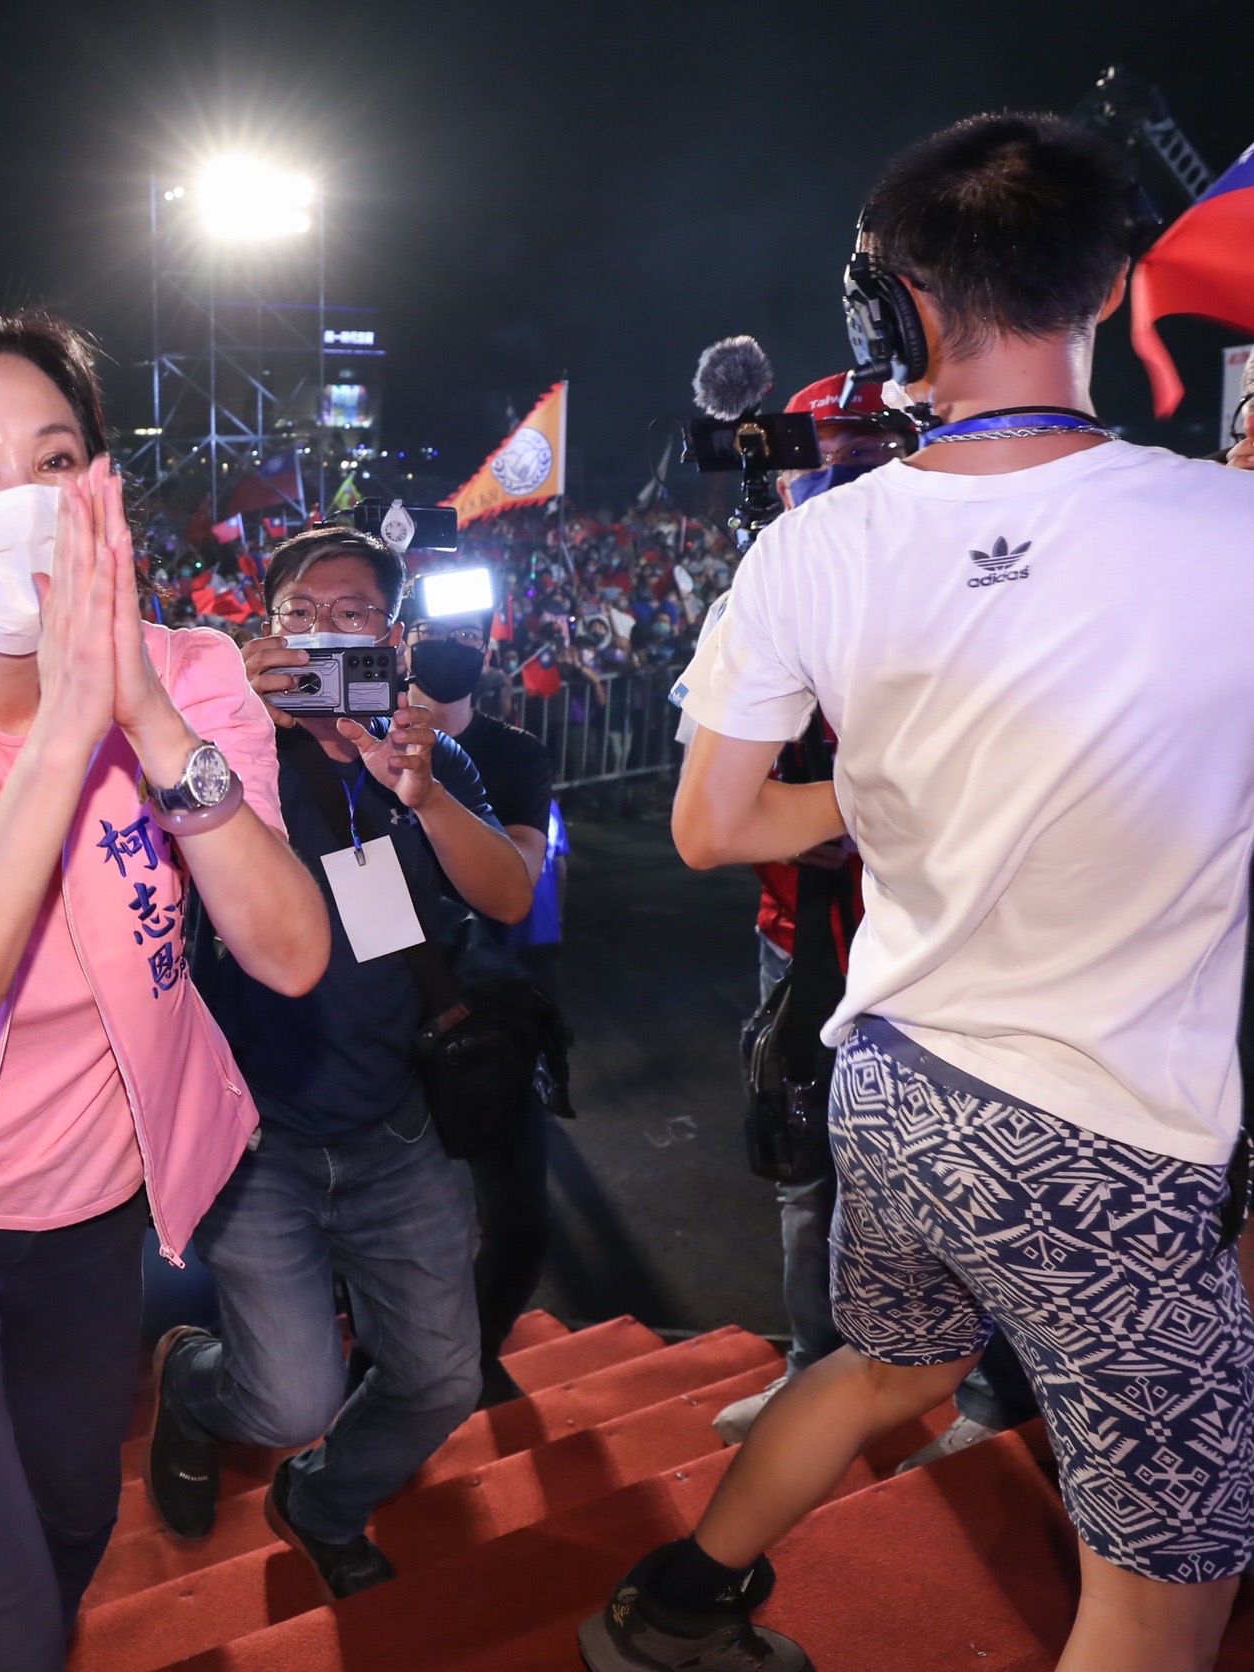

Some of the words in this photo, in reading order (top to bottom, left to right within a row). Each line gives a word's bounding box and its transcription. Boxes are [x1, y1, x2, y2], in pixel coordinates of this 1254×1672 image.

[967, 568, 1030, 588] adidas
[96, 815, 180, 1000] 柯志恩
